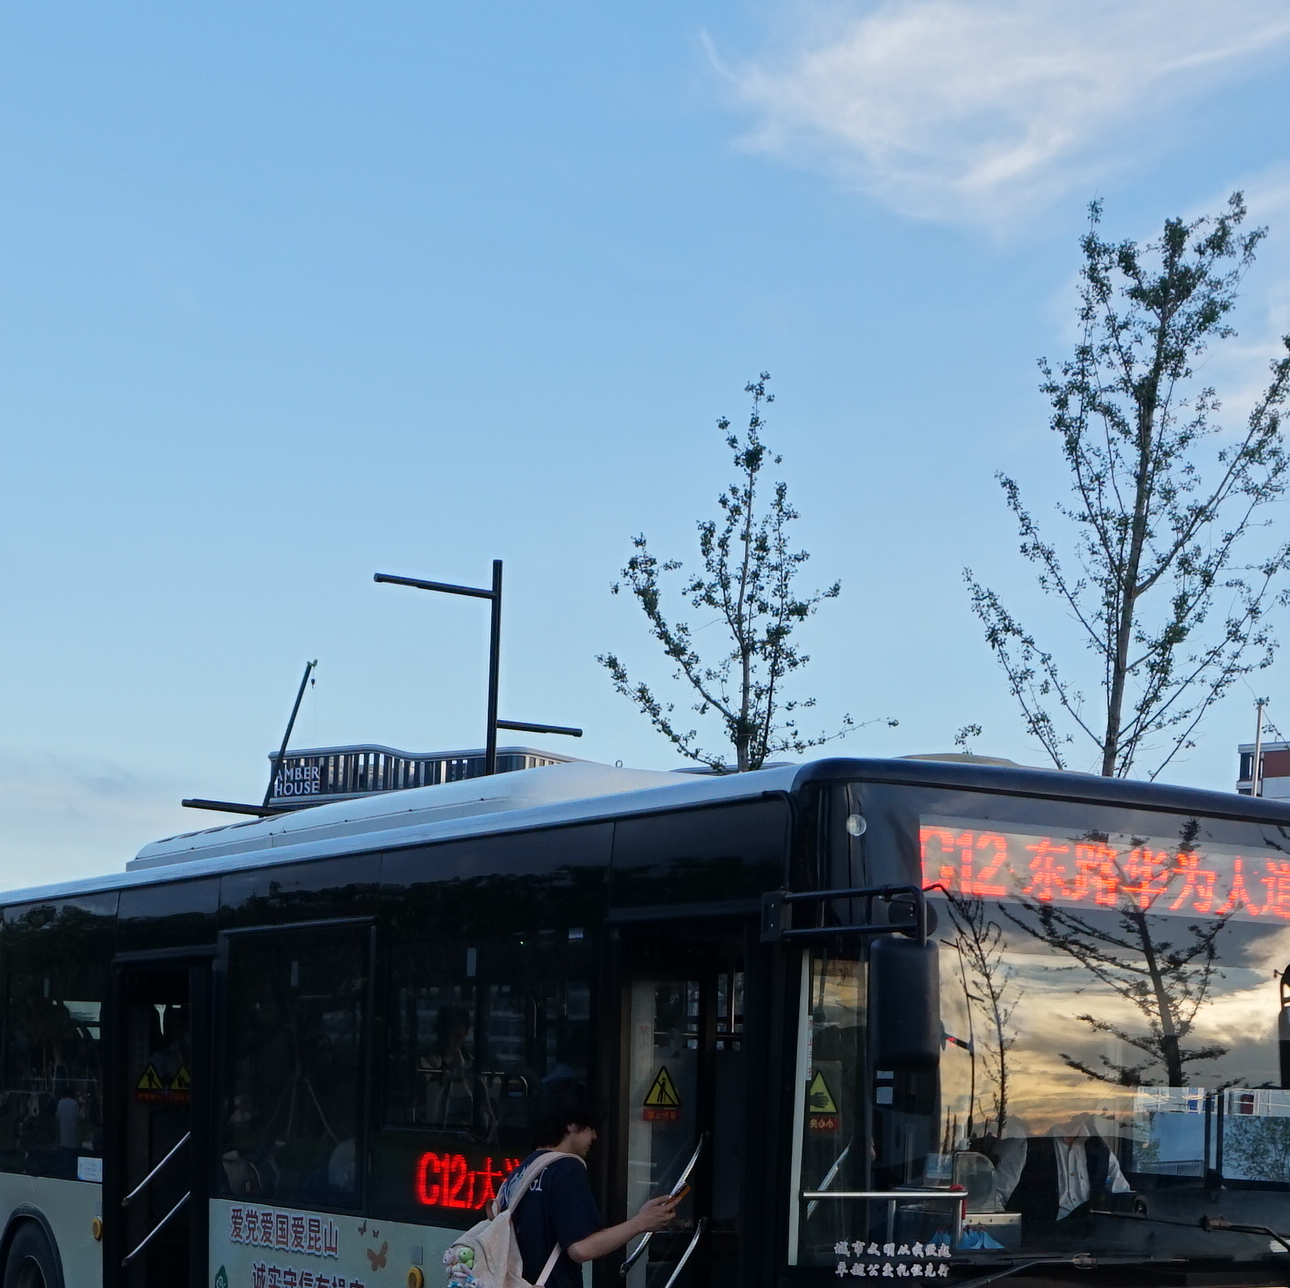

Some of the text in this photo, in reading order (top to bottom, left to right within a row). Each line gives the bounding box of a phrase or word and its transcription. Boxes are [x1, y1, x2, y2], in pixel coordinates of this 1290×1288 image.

[276, 766, 320, 781] AMBER
[274, 781, 320, 797] HOUSE
[231, 1208, 339, 1258] 爱党爱国爱昆山
[834, 1240, 952, 1258] 城市文明从我做起
